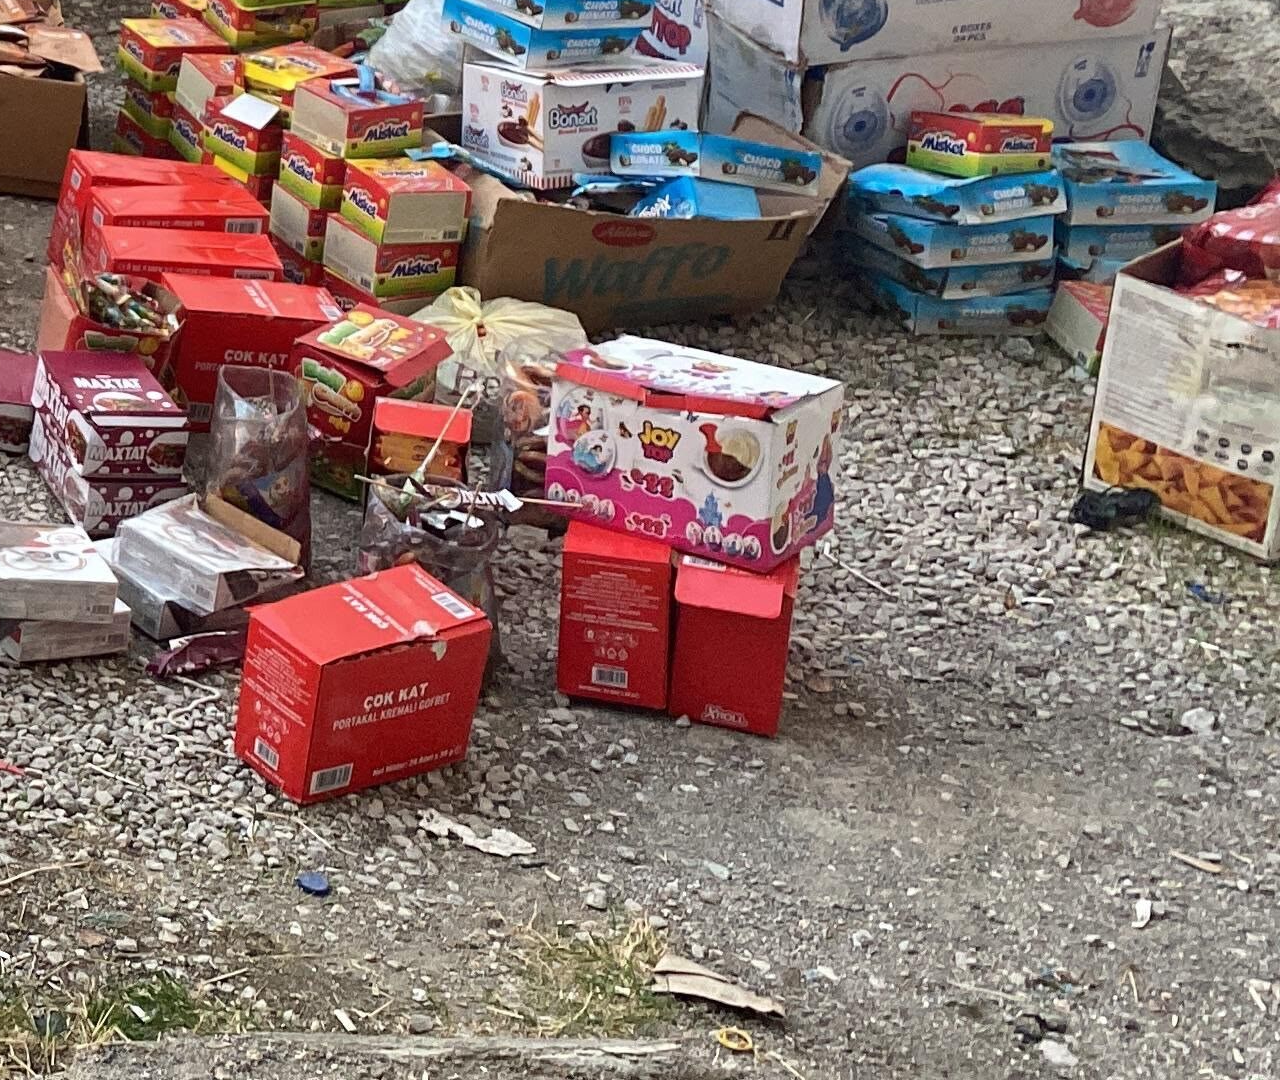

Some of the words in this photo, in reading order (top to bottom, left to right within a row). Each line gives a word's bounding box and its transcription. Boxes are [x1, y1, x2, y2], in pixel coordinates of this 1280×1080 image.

[960, 22, 992, 33] BOXES
[548, 106, 598, 129] Bonart
[363, 121, 409, 141] Misket
[921, 133, 967, 155] Misket
[392, 260, 441, 278] Misket
[259, 352, 289, 366] KAT
[73, 377, 142, 391] MAXTAT
[639, 420, 681, 450] JOY
[88, 445, 145, 461] MAXTAT
[88, 499, 146, 518] MAXTAT
[363, 690, 394, 712] ÇOK
[399, 682, 428, 701] KAT
[333, 712, 378, 731] PORTAKAL
[419, 692, 450, 710] GOFRET
